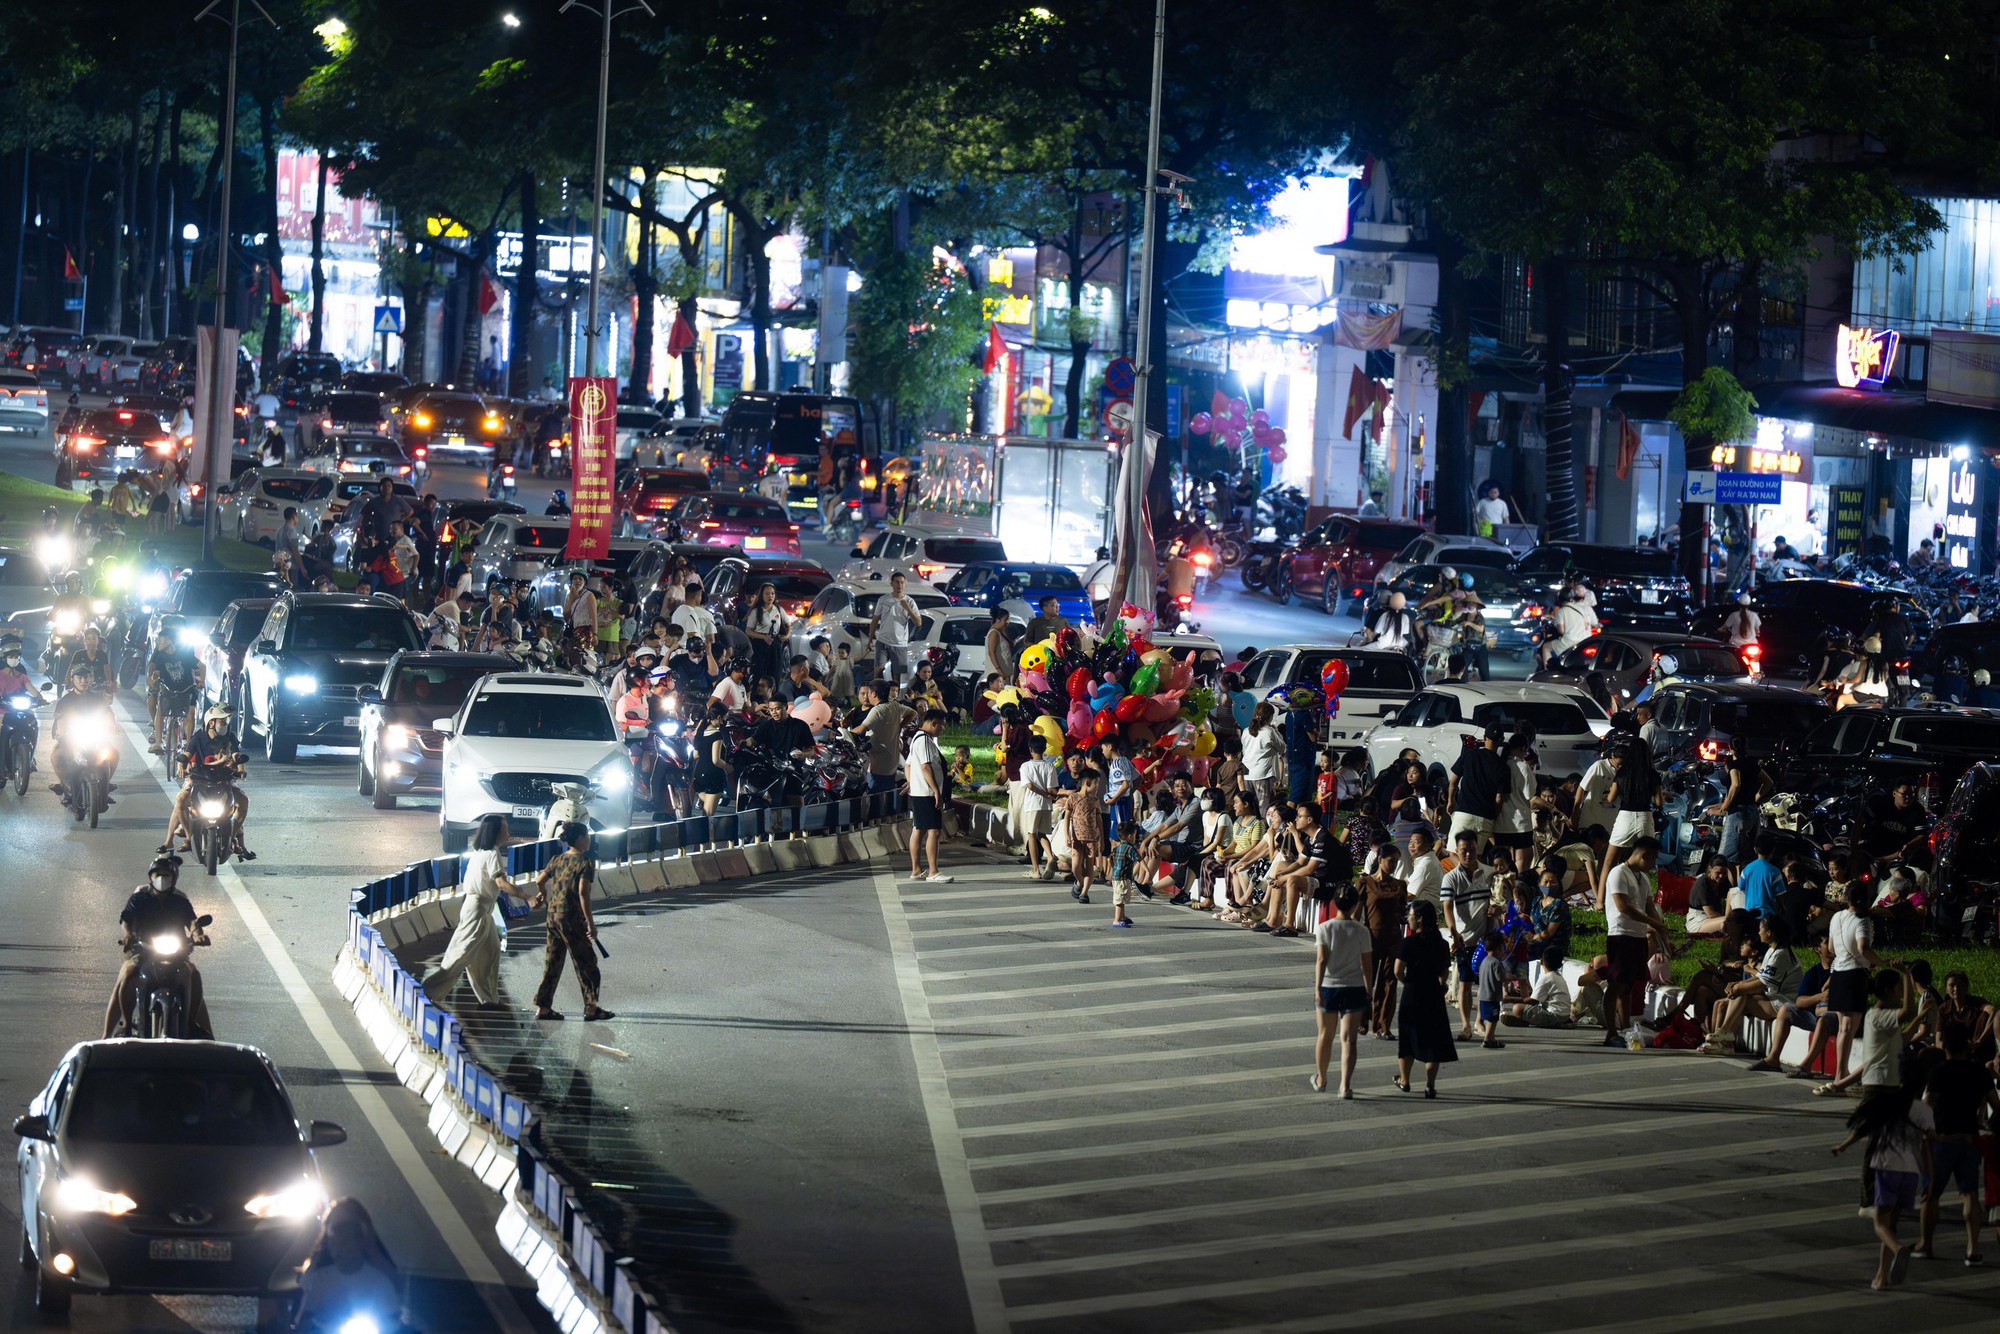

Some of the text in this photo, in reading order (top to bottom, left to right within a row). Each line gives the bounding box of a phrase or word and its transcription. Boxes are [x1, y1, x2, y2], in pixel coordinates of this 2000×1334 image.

[718, 335, 739, 360] P
[1765, 481, 1780, 489] HAY
[1737, 491, 1748, 499] RA
[1839, 490, 1863, 503] THAY
